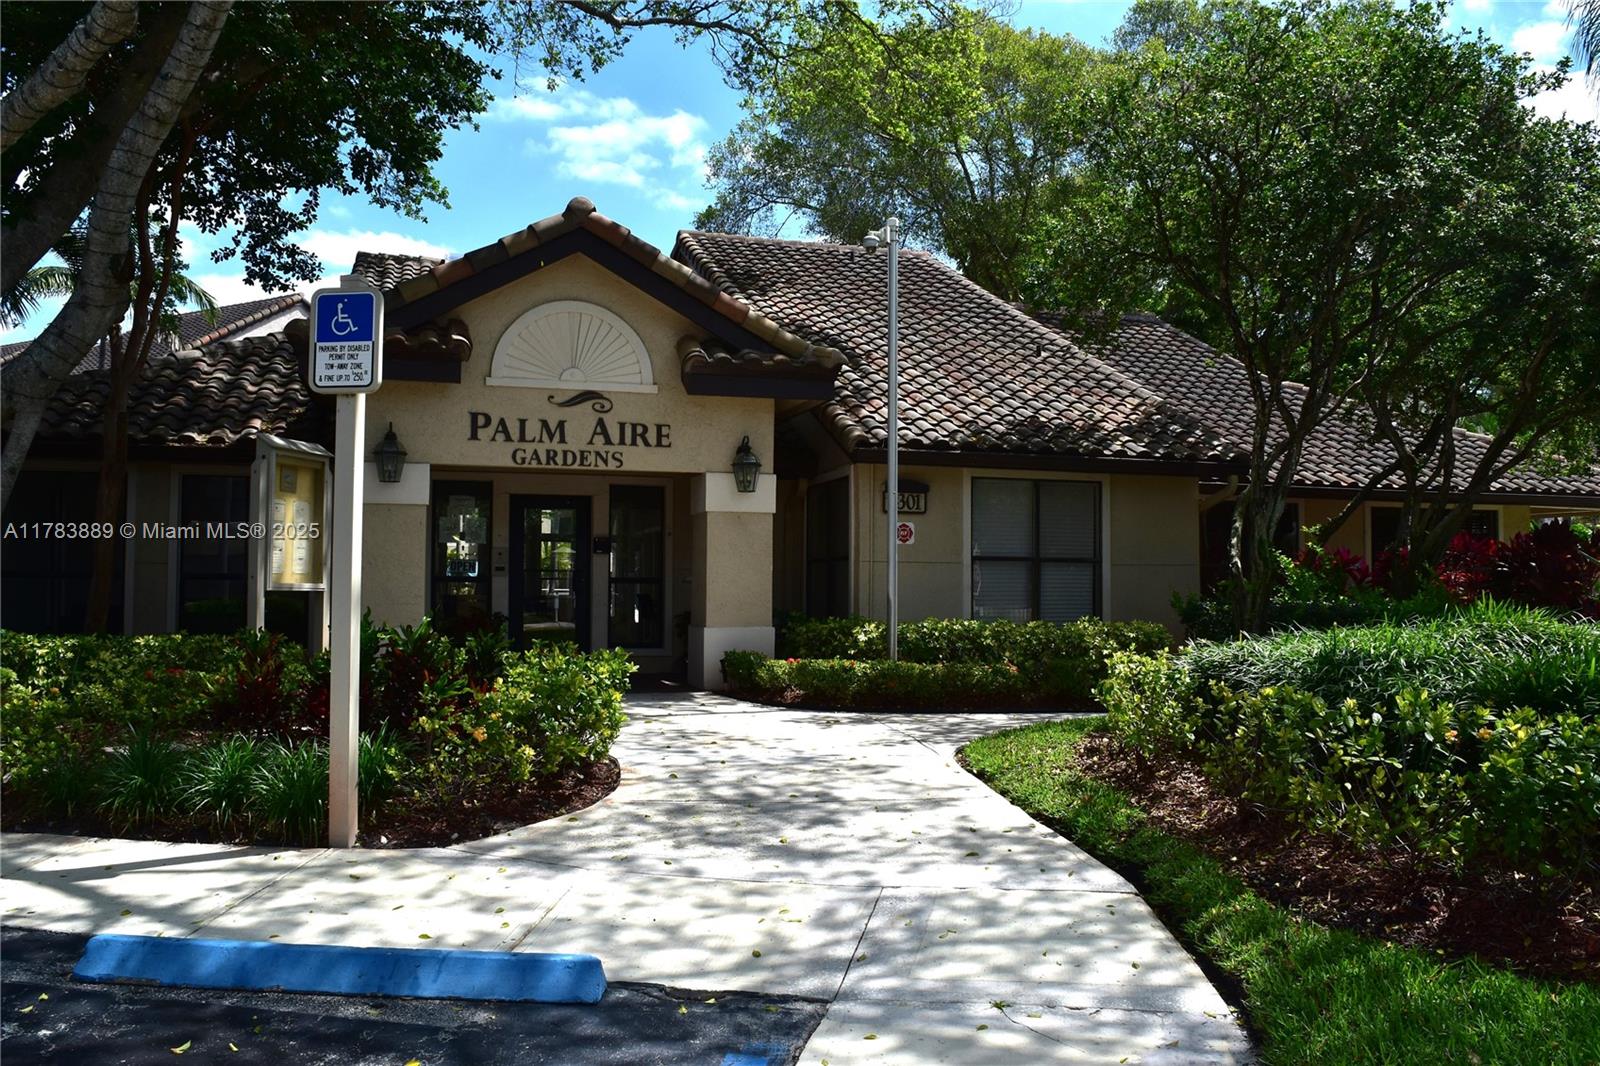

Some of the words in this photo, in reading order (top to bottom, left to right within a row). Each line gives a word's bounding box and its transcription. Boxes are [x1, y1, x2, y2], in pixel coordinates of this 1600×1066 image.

[347, 344, 370, 352] DISABLED
[325, 362, 348, 370] TOW-AWAY
[350, 362, 363, 370] ZONE
[336, 374, 343, 382] UP
[344, 374, 350, 382] TO
[468, 411, 568, 444] PALM
[587, 416, 672, 448] AIRE
[511, 448, 624, 468] GARDENS
[450, 561, 475, 572] OPEN
